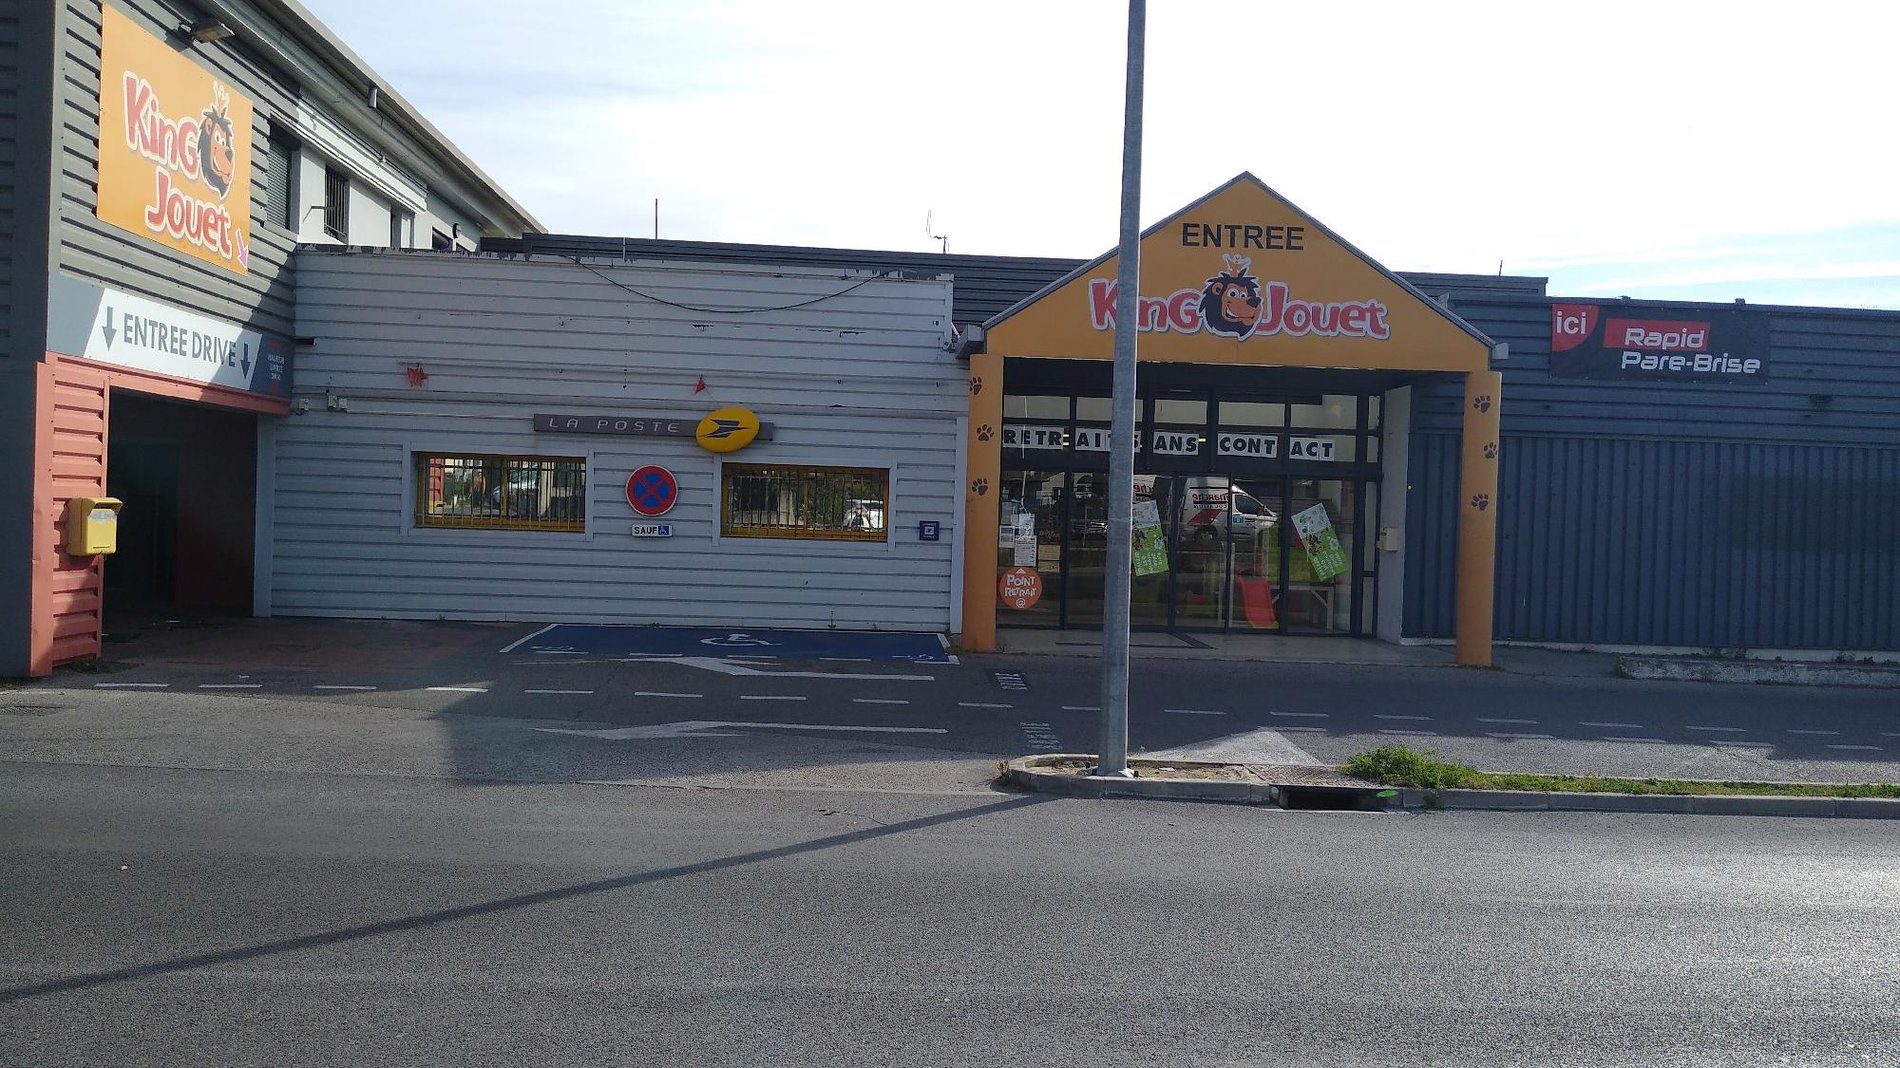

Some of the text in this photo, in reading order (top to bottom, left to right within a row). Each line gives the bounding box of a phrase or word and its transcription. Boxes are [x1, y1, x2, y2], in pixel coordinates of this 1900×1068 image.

[147, 170, 232, 258] Jouet
[1182, 223, 1305, 250] ENTREE
[1256, 282, 1388, 338] Jouet
[1556, 311, 1587, 335] ici
[123, 312, 237, 367] ENTREE DRIVE
[1623, 327, 1705, 350] Rapid
[1621, 350, 1761, 374] Pare-Brise
[549, 417, 681, 433] LA POSTE
[634, 526, 658, 535] SAUF
